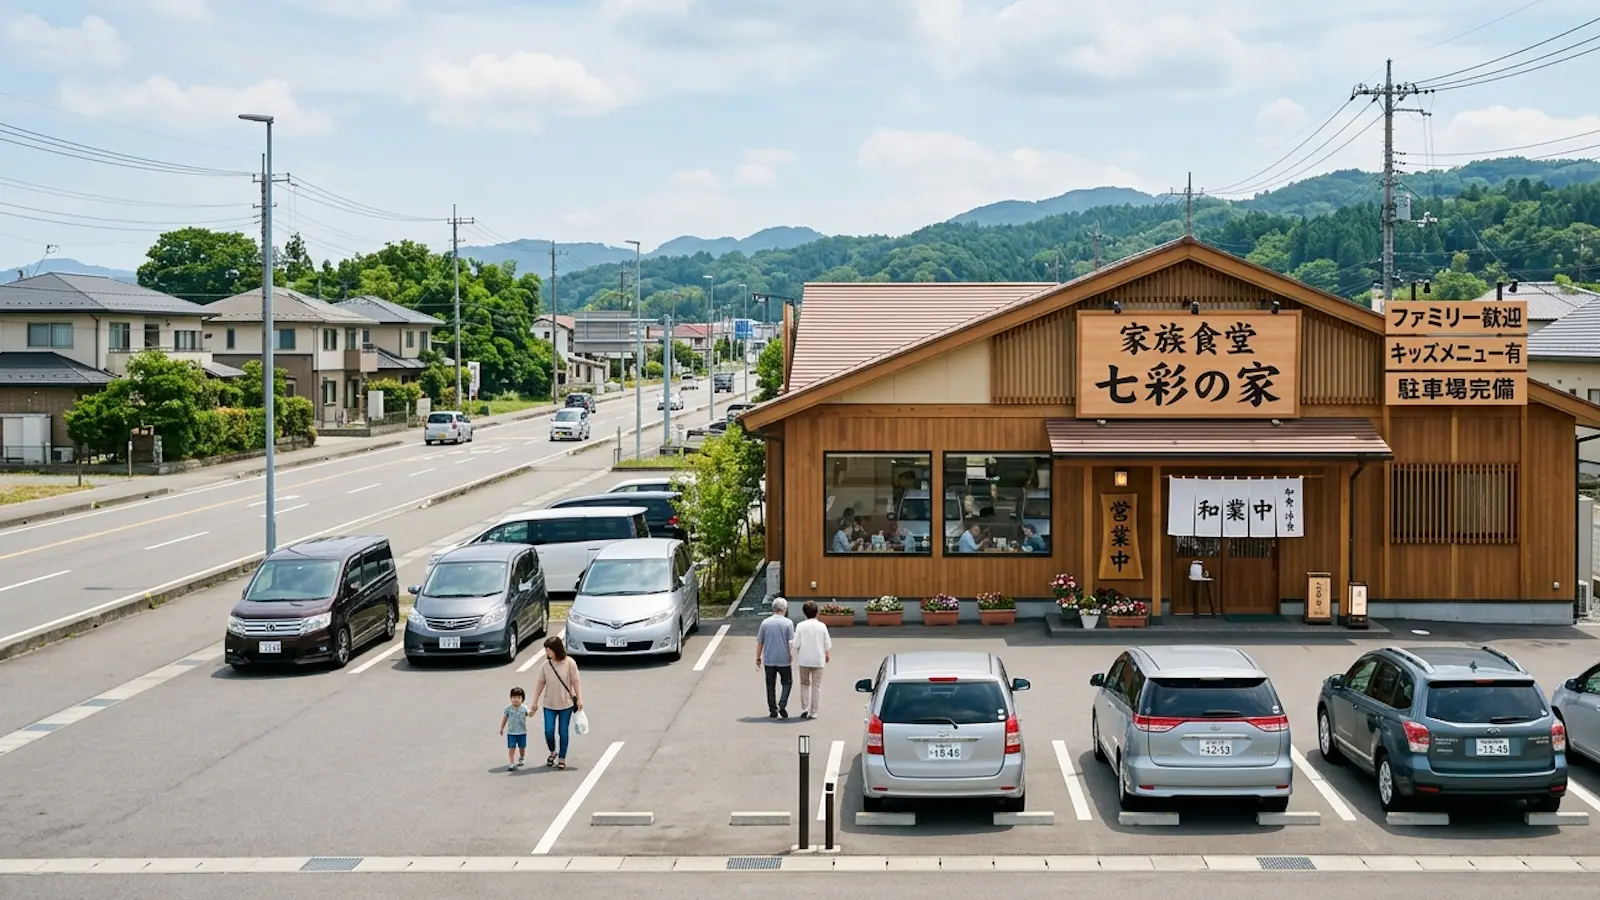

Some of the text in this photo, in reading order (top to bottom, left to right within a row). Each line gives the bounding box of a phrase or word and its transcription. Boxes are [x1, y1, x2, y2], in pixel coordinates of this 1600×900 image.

[1392, 306, 1522, 329] ファミリー歓迎
[1119, 324, 1256, 355] 家族食堂
[1391, 342, 1522, 364] キッズメニュー有
[1095, 361, 1280, 408] 七彩の家
[1398, 377, 1515, 402] 駐車場完備
[1198, 498, 1273, 521] 和業中
[1110, 498, 1132, 573] 営業中
